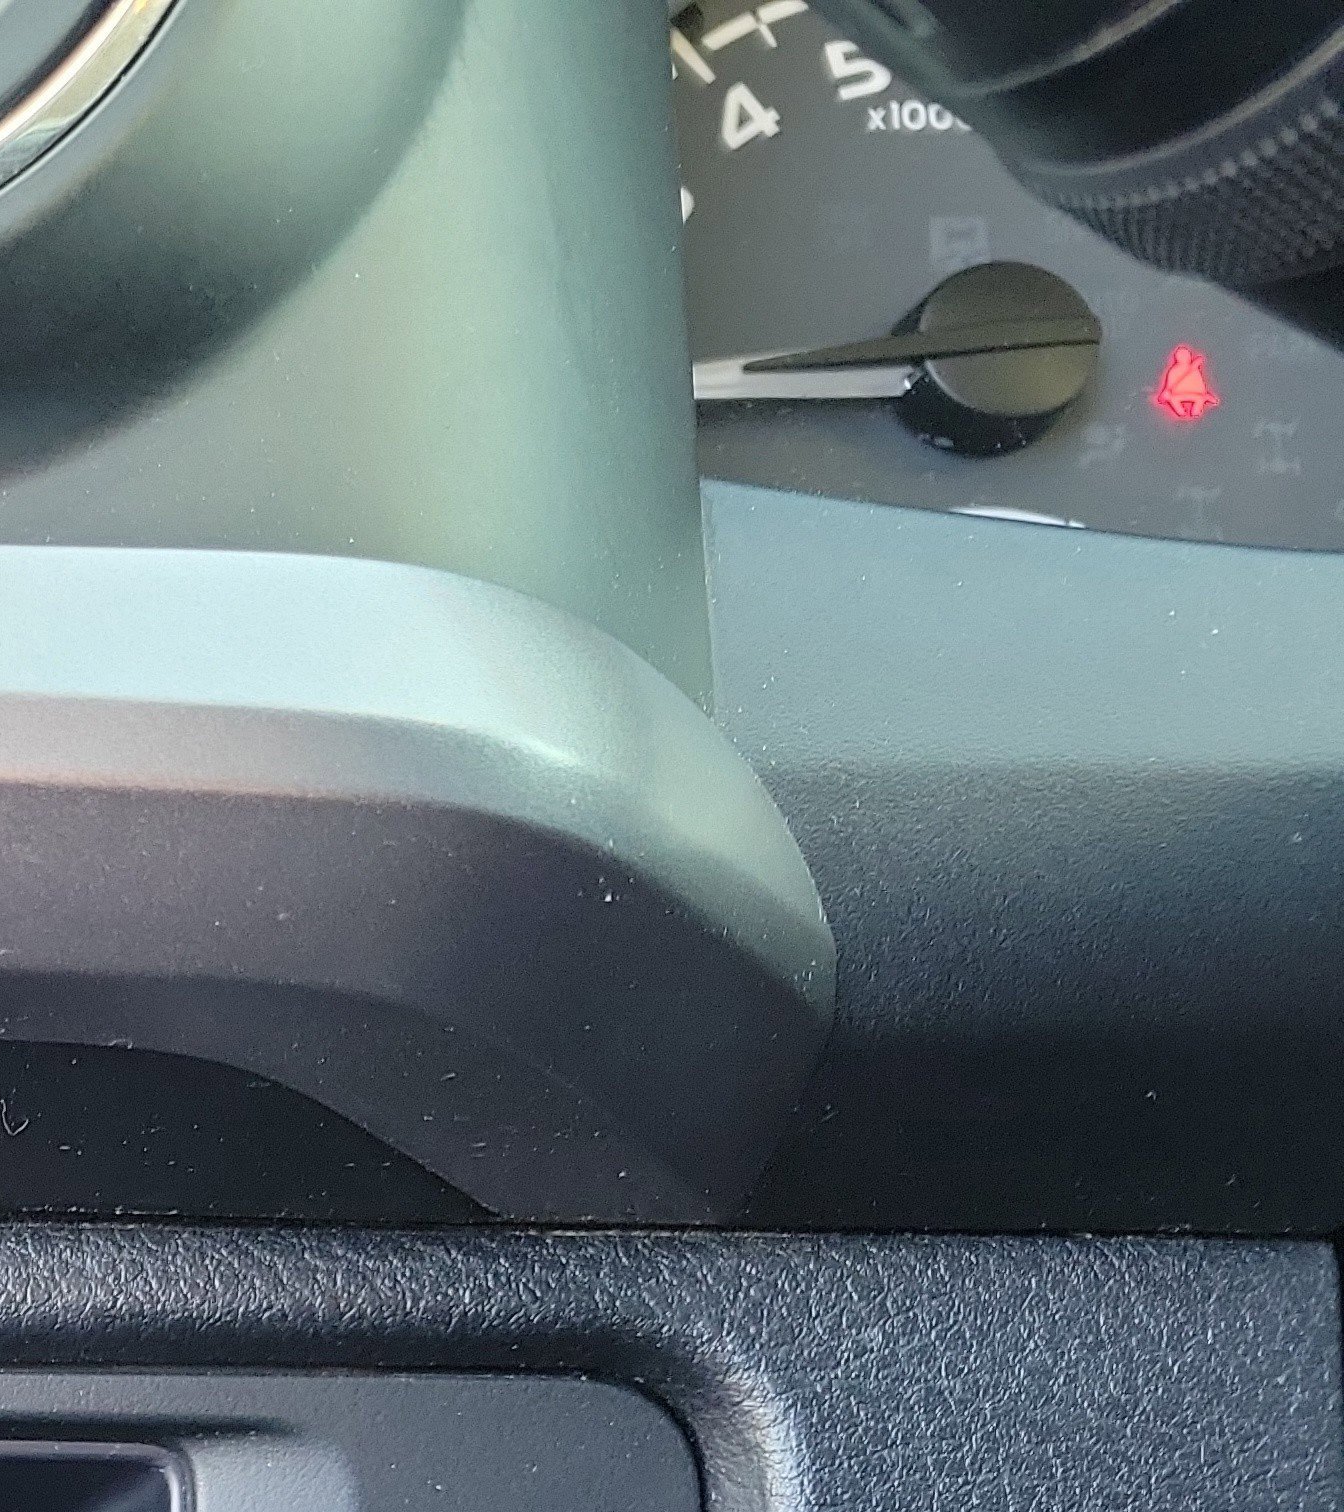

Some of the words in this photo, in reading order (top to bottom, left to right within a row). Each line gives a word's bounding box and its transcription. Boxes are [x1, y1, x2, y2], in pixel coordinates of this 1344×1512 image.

[823, 39, 894, 101] 5
[721, 81, 781, 150] 4
[867, 99, 973, 132] x100
